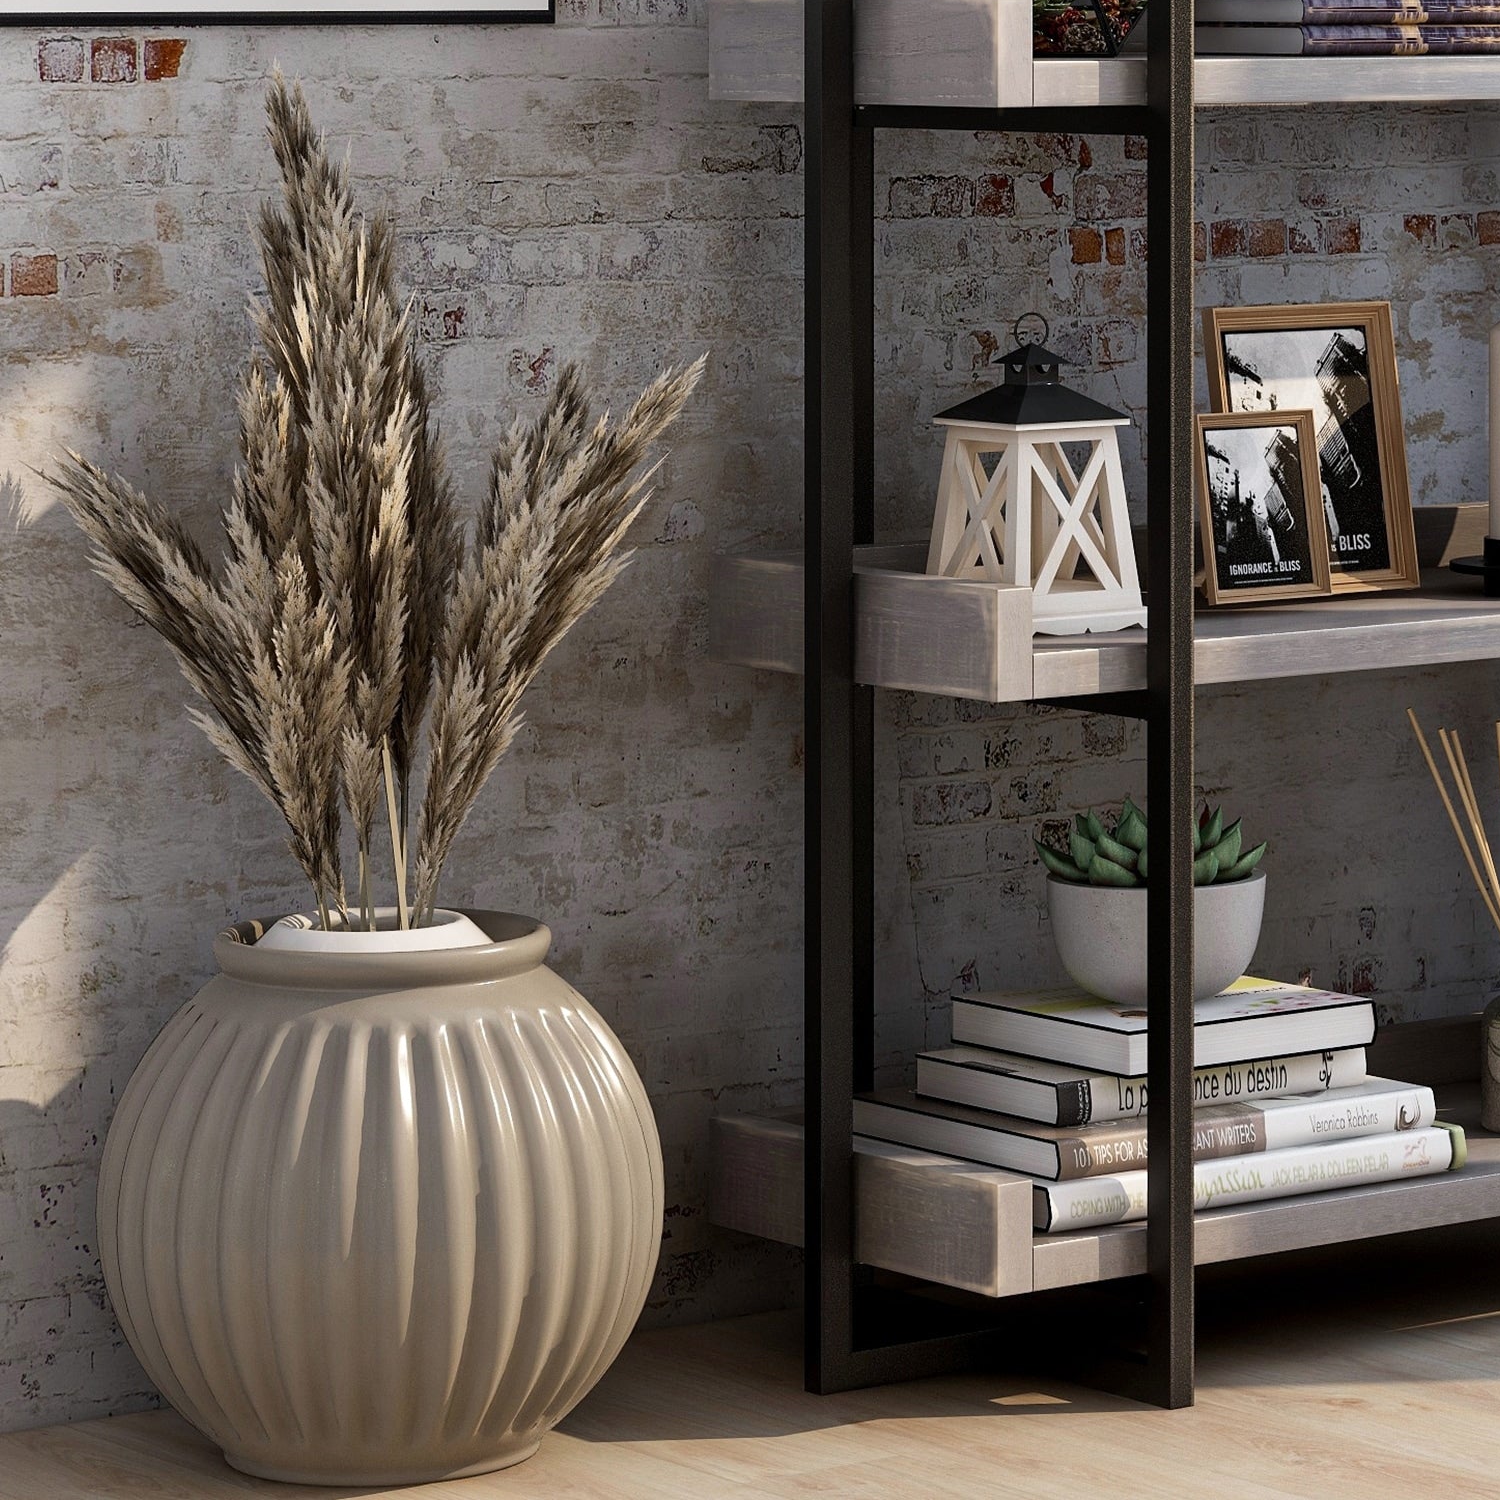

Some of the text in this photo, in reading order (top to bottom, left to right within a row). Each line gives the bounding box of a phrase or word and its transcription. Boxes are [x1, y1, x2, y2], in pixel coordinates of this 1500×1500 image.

[1339, 533, 1372, 551] BLISS
[1229, 562, 1273, 576] IGNORANCE
[1279, 560, 1301, 573] BLISS
[1117, 1077, 1134, 1111] La
[1224, 1065, 1242, 1096] du
[1247, 1060, 1288, 1092] destin
[1309, 1109, 1379, 1133] Veronica Robbins
[1073, 1147, 1092, 1168] 101
[1094, 1143, 1112, 1164] TIPS
[1115, 1141, 1135, 1162] FOR
[1217, 1123, 1257, 1147] WRITERS
[1071, 1197, 1103, 1219] COPING
[1104, 1195, 1126, 1213] WITH
[1271, 1168, 1292, 1187] JACK
[1327, 1158, 1362, 1178] COLLEEN
